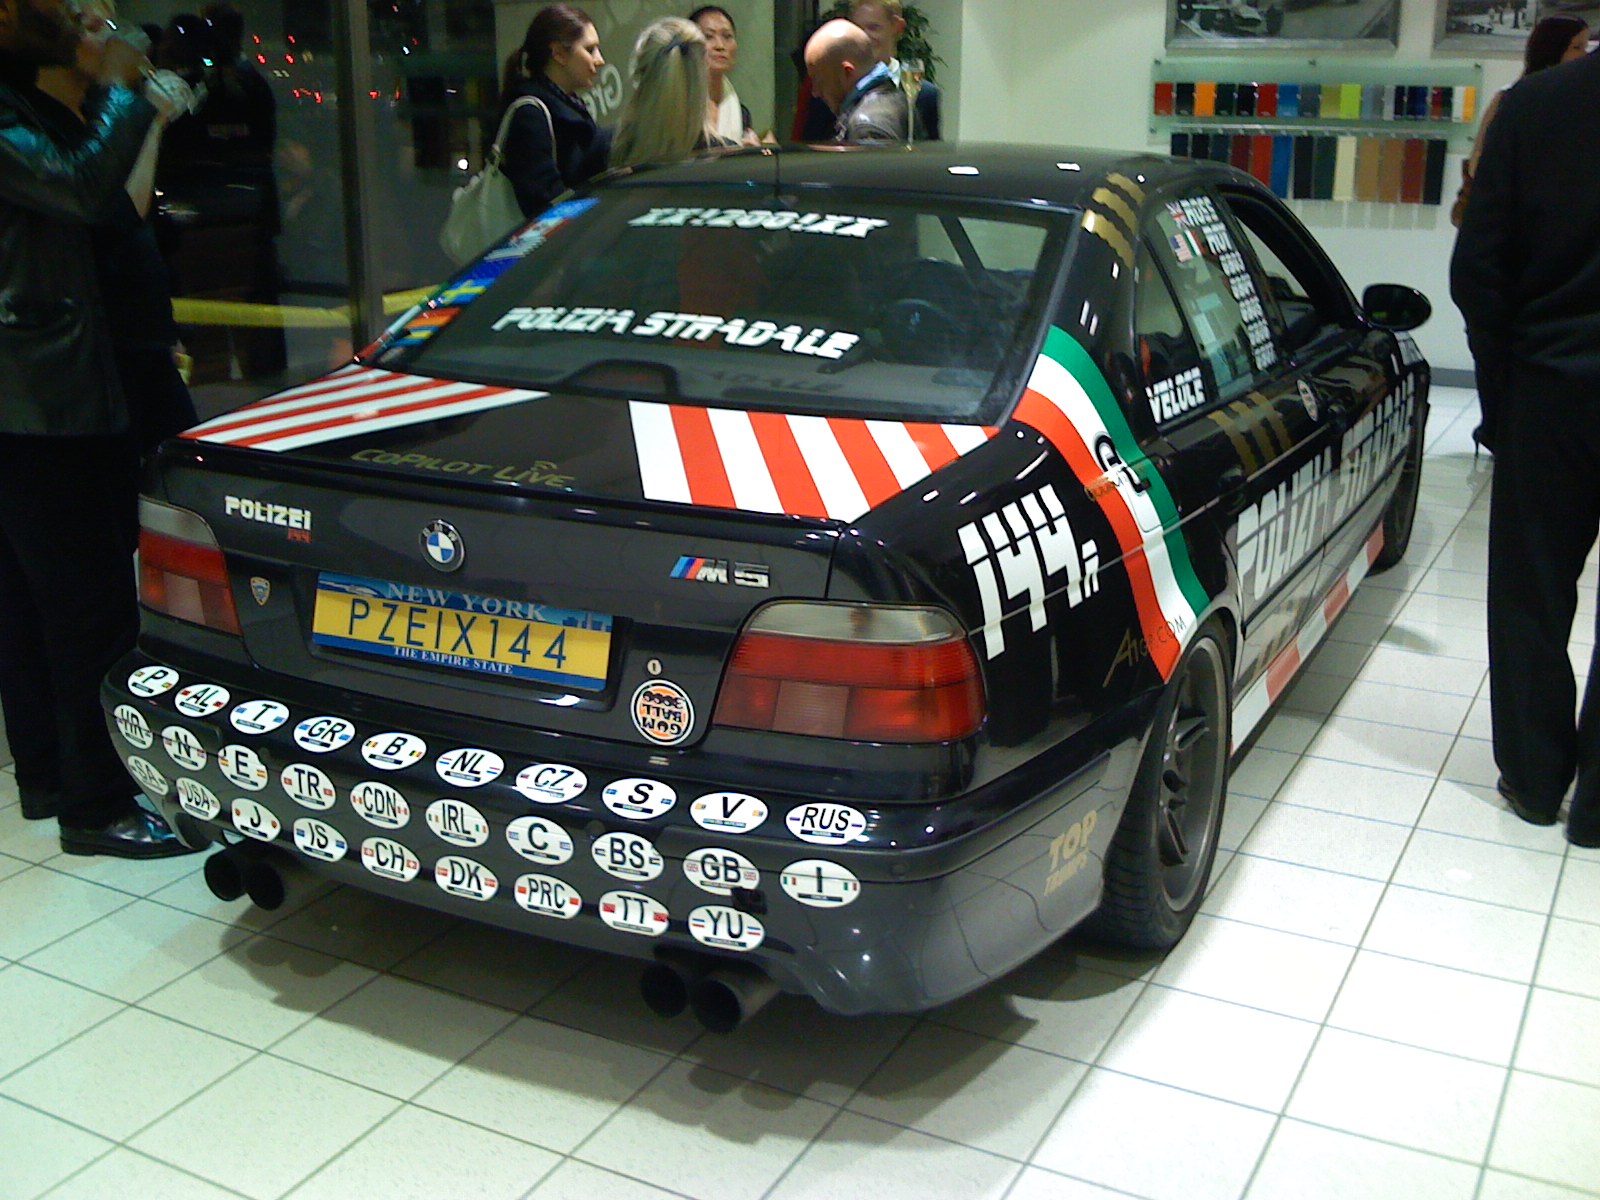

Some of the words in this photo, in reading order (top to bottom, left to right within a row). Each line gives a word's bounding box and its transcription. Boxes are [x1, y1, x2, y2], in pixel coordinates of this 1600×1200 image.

[491, 306, 636, 334] POLIZIA
[632, 310, 860, 360] STRADALE
[1145, 366, 1206, 424] VELOCE
[224, 495, 312, 531] POLIZEI
[387, 582, 450, 607] NEW
[462, 593, 548, 622] YORK
[348, 597, 568, 669] PZEIX144
[394, 645, 418, 660] THE
[421, 648, 471, 668] EMPIRE
[473, 659, 514, 675] STATE
[142, 669, 169, 684] P
[185, 687, 219, 707] AL
[120, 708, 144, 739] HR
[252, 703, 278, 721] T
[642, 703, 682, 722] BALL
[642, 717, 682, 735] GUM
[174, 731, 191, 758] N
[308, 719, 347, 742] GR
[382, 736, 408, 756] B
[235, 750, 250, 778] E
[451, 751, 485, 775] NL
[534, 767, 575, 788] CZ
[182, 780, 211, 811] USA
[294, 767, 322, 799] TR
[628, 783, 654, 805] S
[250, 805, 261, 828] J
[363, 786, 397, 818] CDN
[722, 796, 746, 819] V
[442, 803, 472, 835] IRL
[801, 806, 851, 831] RUS
[308, 822, 328, 849] IS
[528, 822, 548, 851] C
[375, 842, 405, 871] CH
[610, 837, 645, 869] BS
[449, 859, 483, 891] DK
[701, 853, 742, 883] GB
[815, 866, 823, 893] I
[527, 877, 566, 909] PRC
[616, 894, 649, 924] TT
[705, 908, 743, 939] YU
